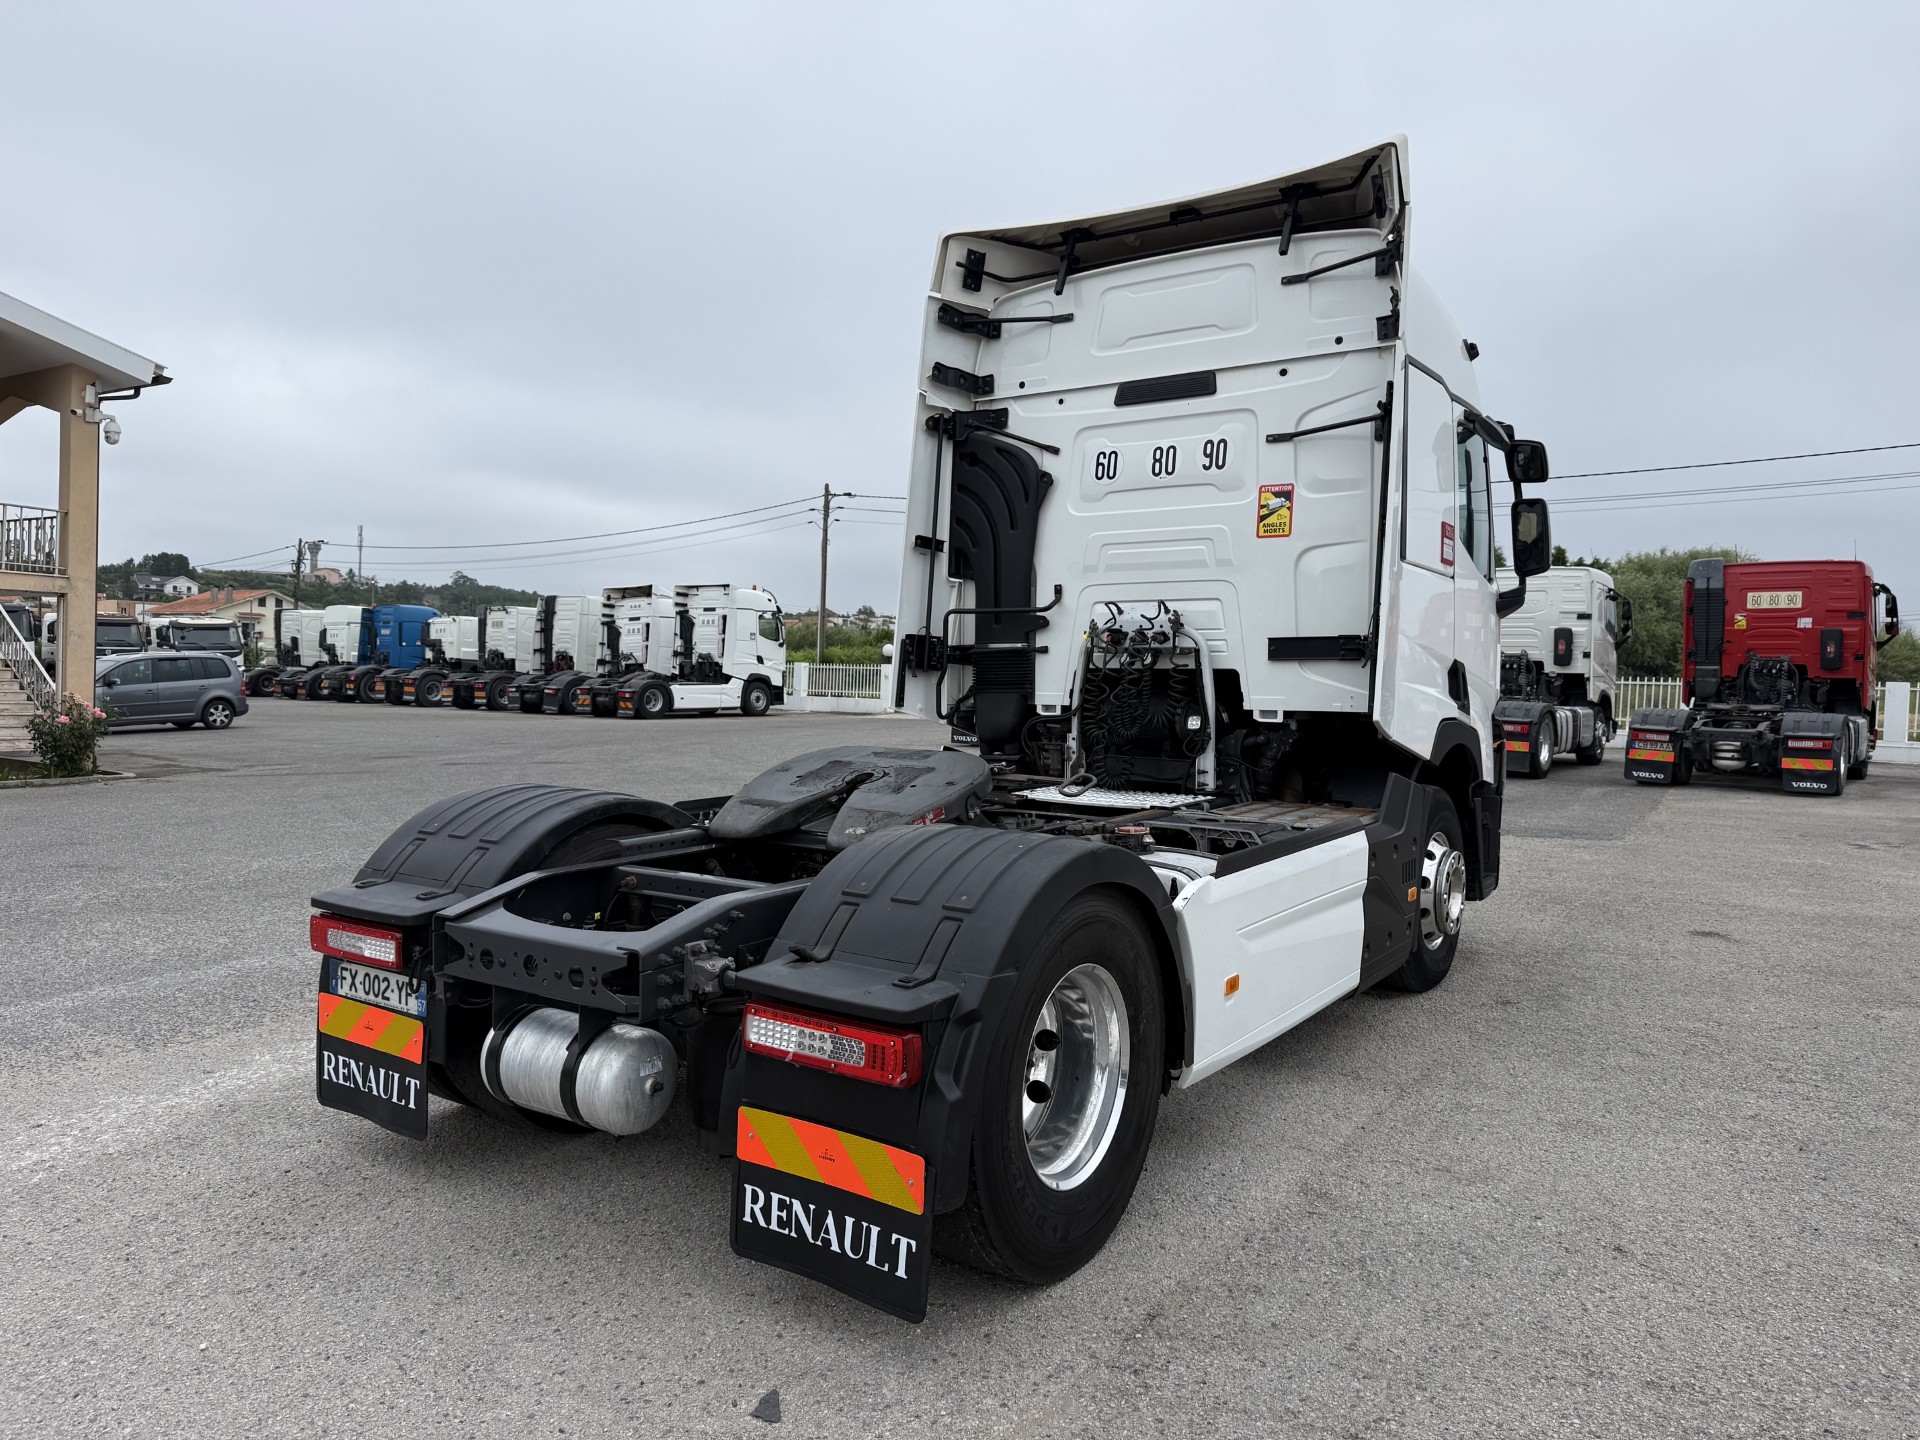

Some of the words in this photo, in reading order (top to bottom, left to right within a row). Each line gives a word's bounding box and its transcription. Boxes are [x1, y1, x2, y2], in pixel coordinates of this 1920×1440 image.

[1094, 450, 1119, 481] 60
[1151, 444, 1177, 478] 80
[1201, 438, 1228, 471] 90
[1751, 595, 1762, 606] 60
[1769, 595, 1780, 606] 80
[1786, 594, 1797, 605] 90
[1632, 771, 1664, 779] VOLVO
[1791, 780, 1828, 789] VOLVO
[417, 999, 426, 1012] 57
[322, 1050, 420, 1109] RENAULT
[742, 1183, 917, 1279] RENAULT
